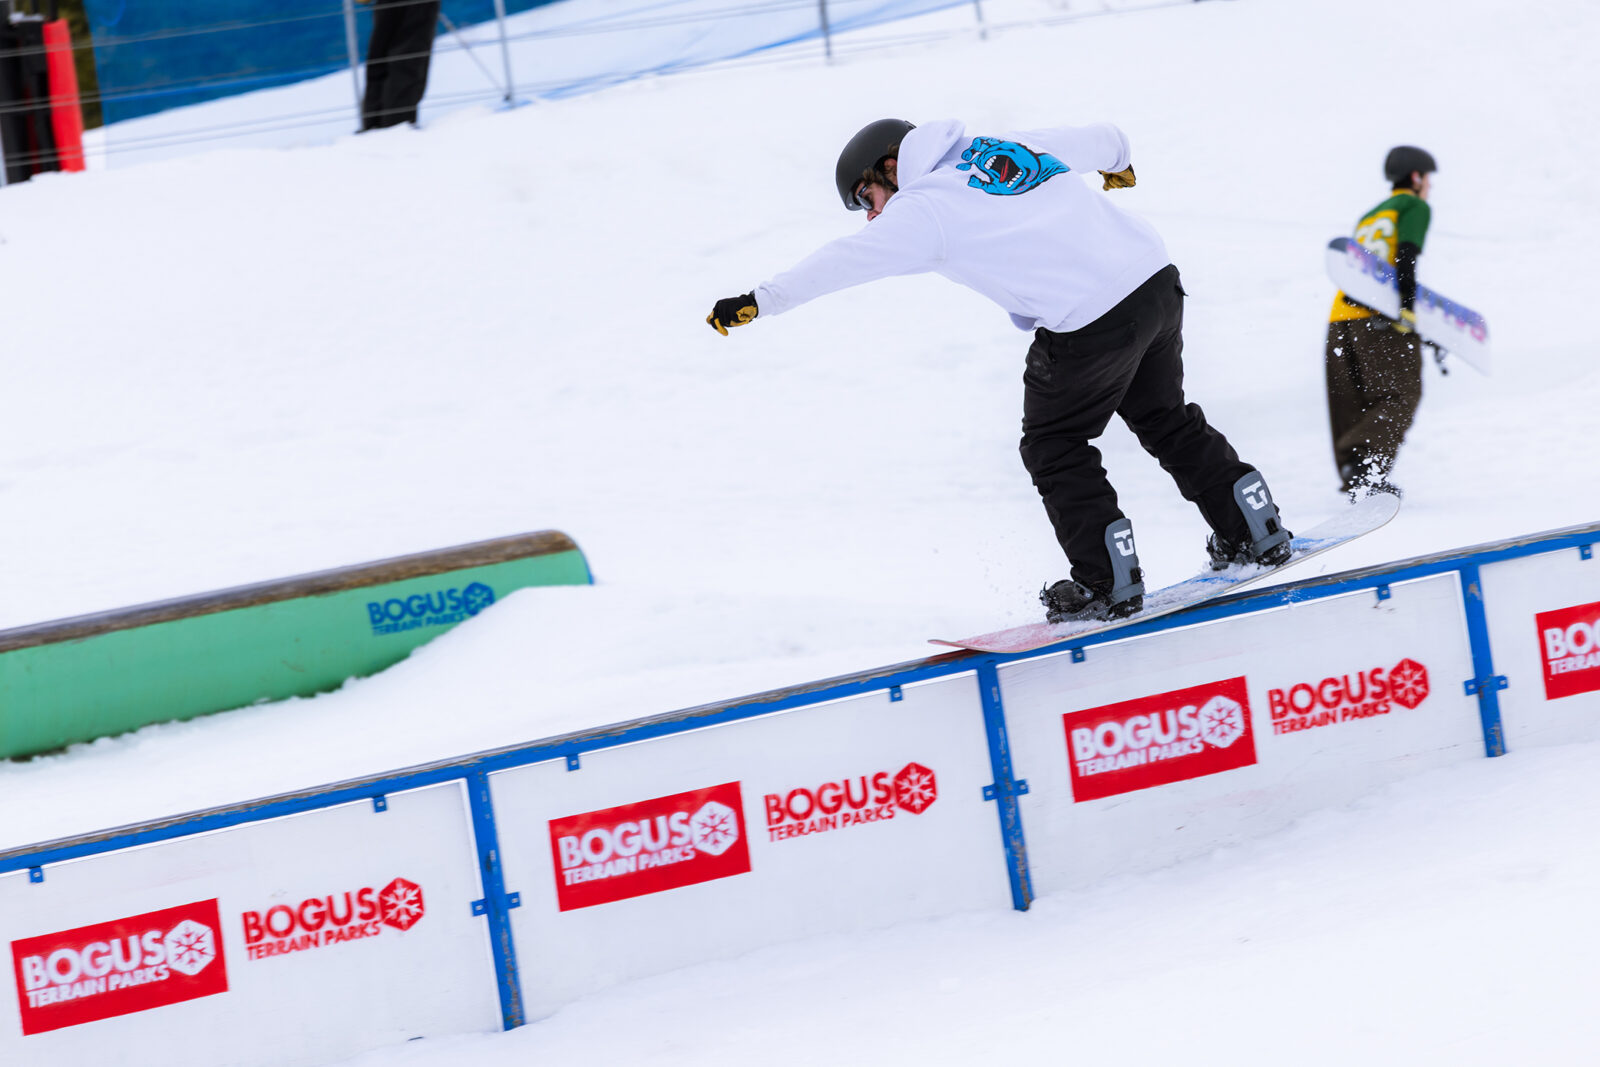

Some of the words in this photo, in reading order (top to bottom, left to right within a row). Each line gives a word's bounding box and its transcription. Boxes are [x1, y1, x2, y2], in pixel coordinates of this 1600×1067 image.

[367, 588, 463, 625] BOGUS
[1544, 618, 1600, 660] BO
[1268, 667, 1391, 721] BOGUS
[1071, 705, 1203, 761] BOGUS
[1272, 709, 1337, 735] TERRAIN
[1340, 698, 1391, 722] PARKS
[1076, 747, 1146, 777] TERRAIN
[1149, 736, 1205, 764] PARKS
[763, 771, 895, 827] BOGUS
[558, 811, 694, 869] BOGUS
[767, 814, 837, 842] TERRAIN
[840, 803, 896, 829] PARKS
[562, 855, 636, 886] TERRAIN
[638, 844, 696, 871] PARKS
[241, 887, 380, 944] BOGUS
[22, 930, 166, 990] BOGUS
[245, 932, 320, 961] TERRAIN
[323, 920, 382, 947] PARKS
[26, 974, 106, 1008] TERRAIN
[108, 963, 170, 991] PARKS
